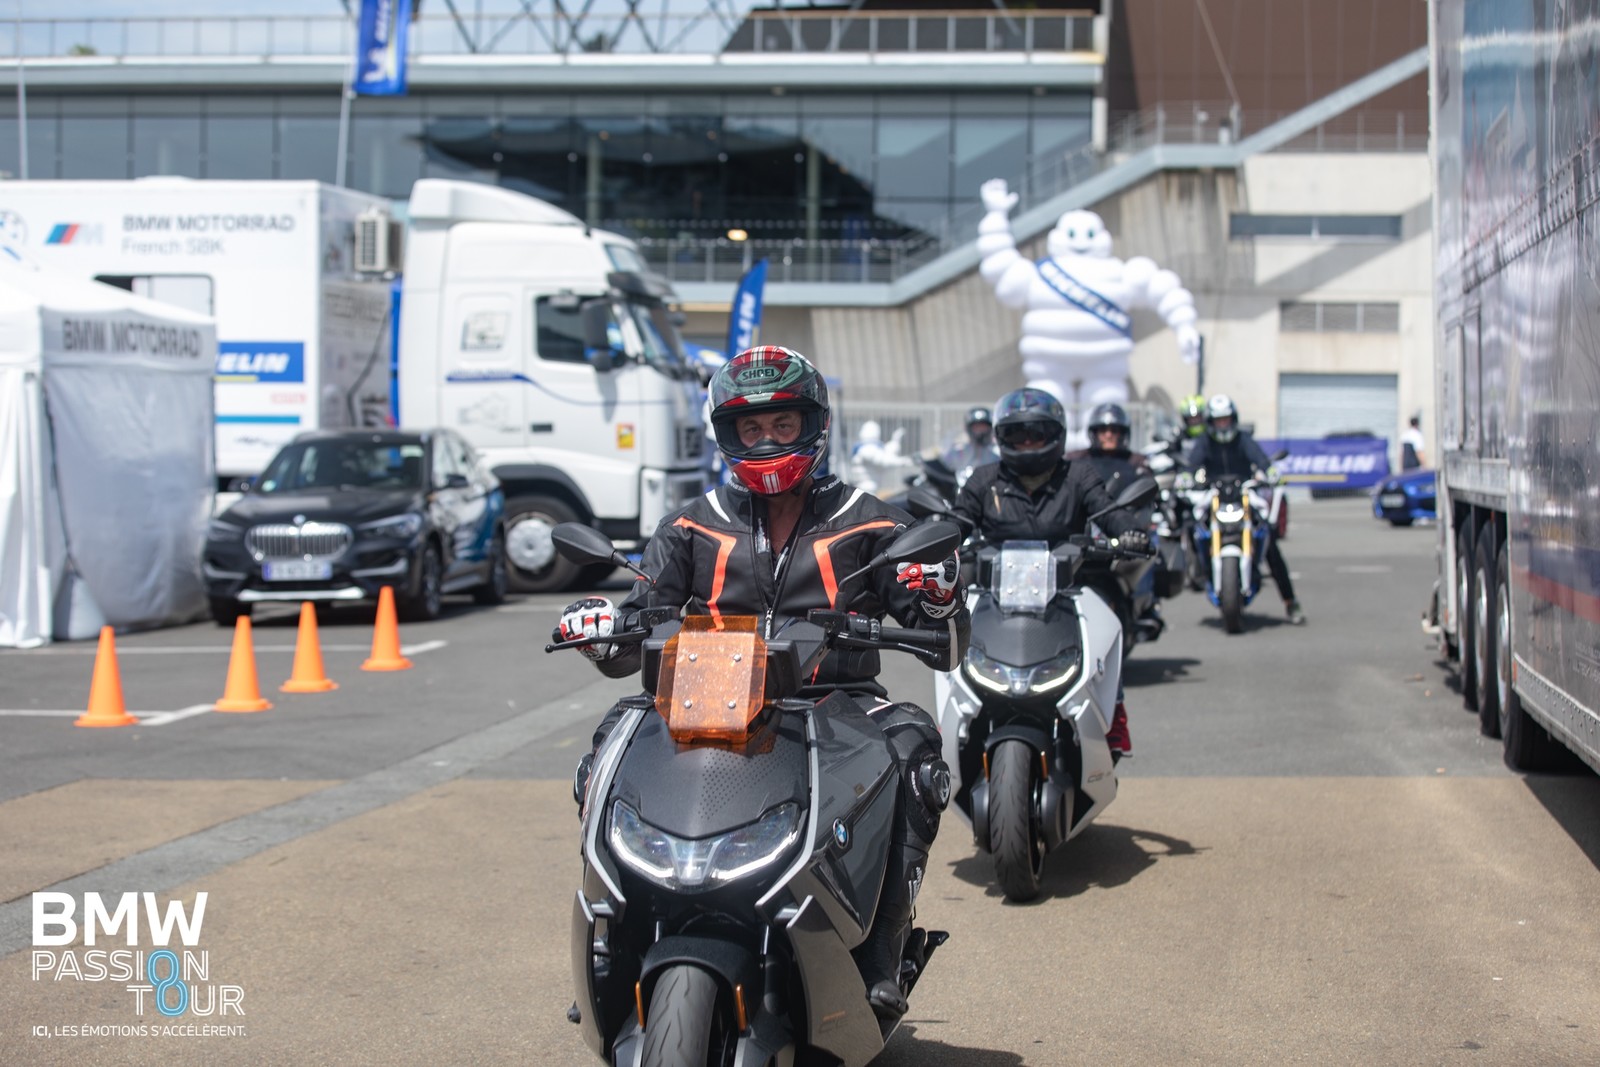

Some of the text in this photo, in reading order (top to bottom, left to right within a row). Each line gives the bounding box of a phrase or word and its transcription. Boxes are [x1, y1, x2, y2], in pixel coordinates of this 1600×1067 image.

[122, 214, 297, 232] BMW MOTORRAD
[63, 319, 203, 360] BMW MOTORRAD
[741, 368, 775, 381] SHOEI
